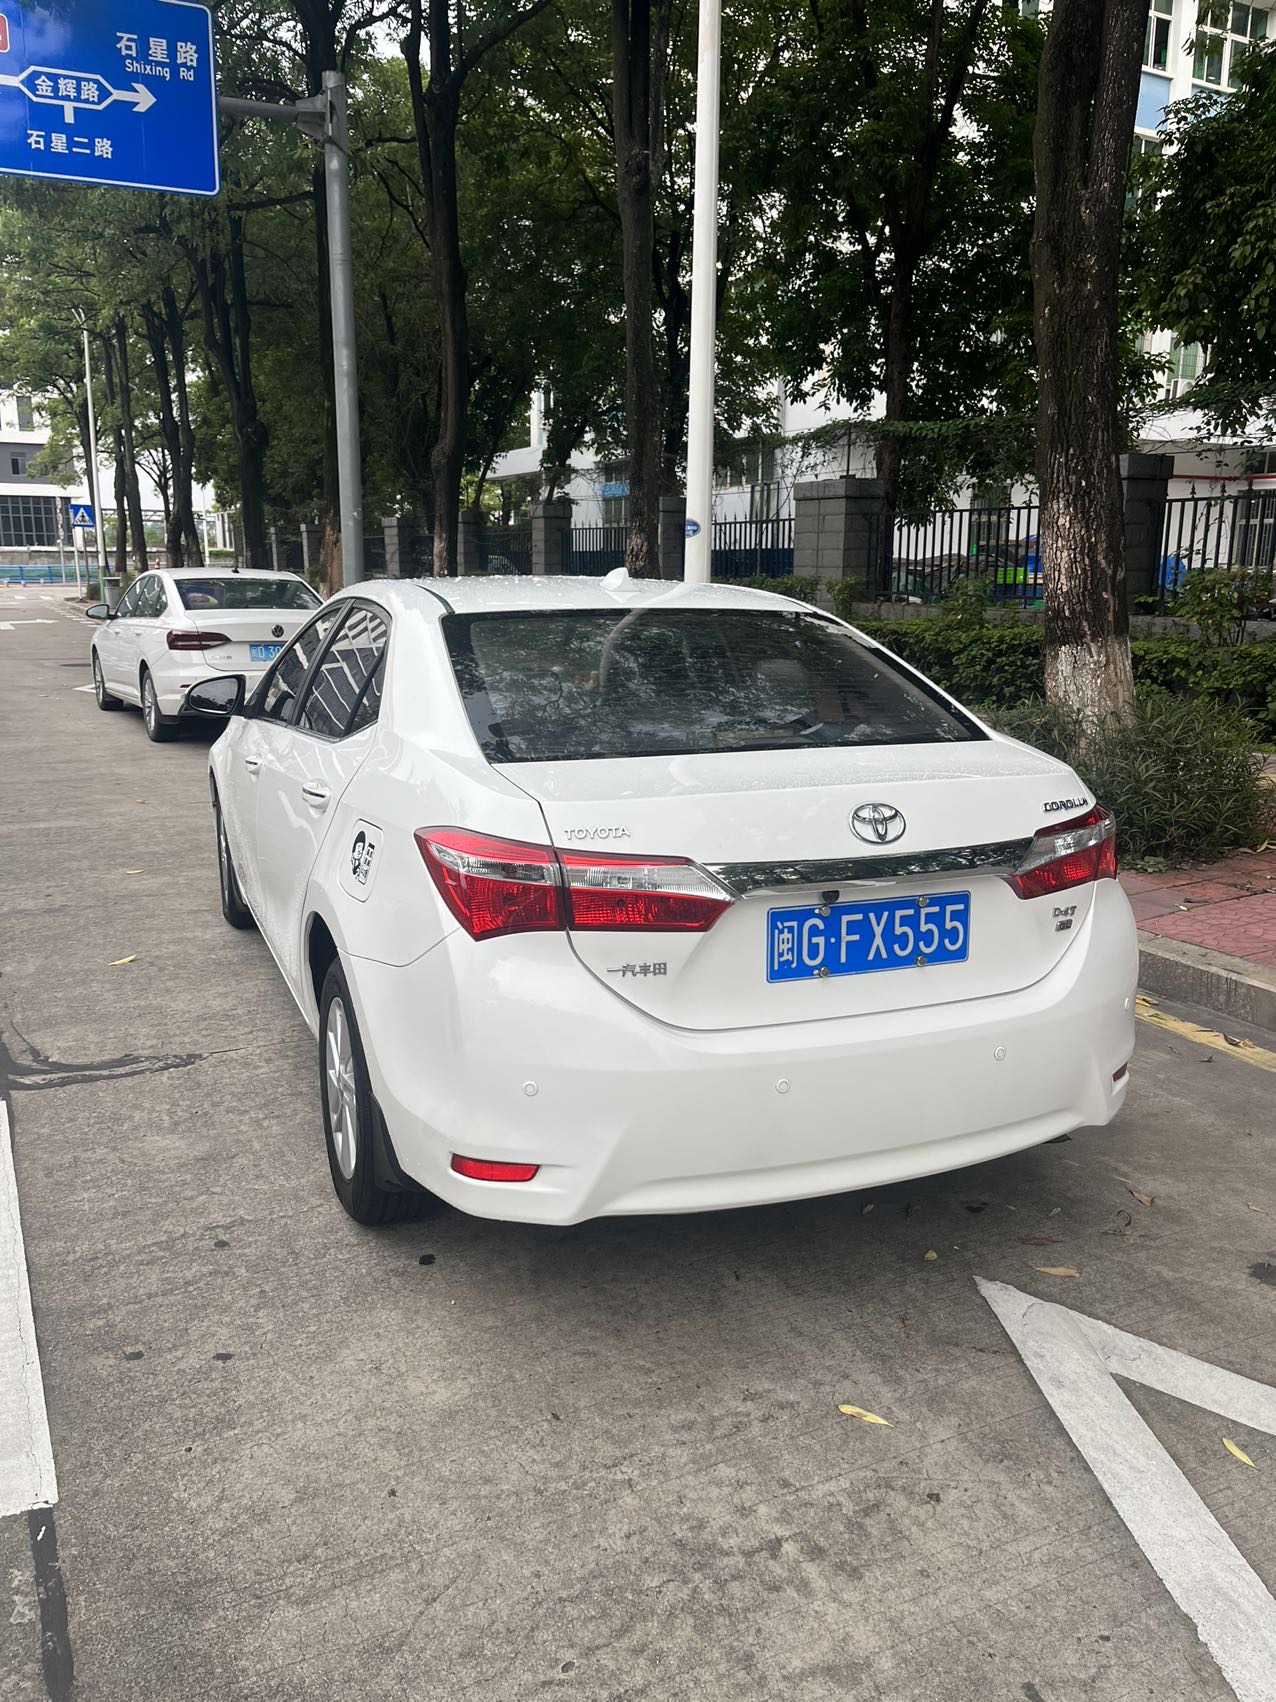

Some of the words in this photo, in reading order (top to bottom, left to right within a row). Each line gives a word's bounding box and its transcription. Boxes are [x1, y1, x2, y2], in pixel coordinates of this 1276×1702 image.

[115, 32, 199, 67] 石星路
[125, 60, 170, 80] Shixing
[179, 68, 194, 81] Rd
[34, 75, 100, 102] 金辉路
[27, 130, 113, 159] 石星二路
[1043, 798, 1088, 812] COROLLA
[565, 825, 630, 840] TOYOTA
[607, 962, 667, 977] 一汽丰田
